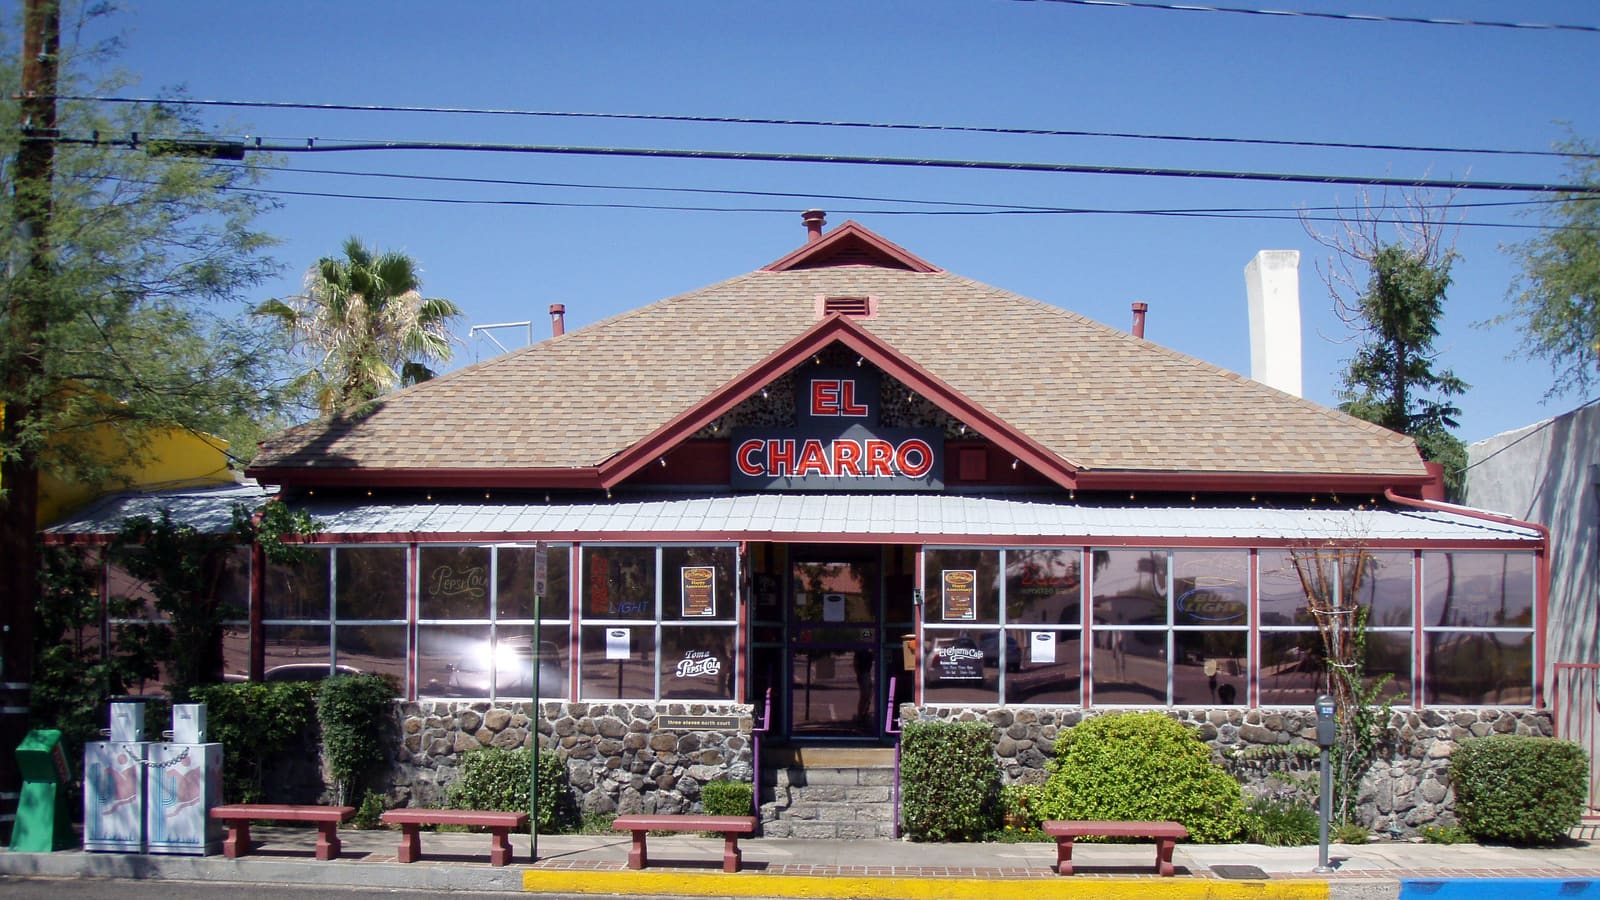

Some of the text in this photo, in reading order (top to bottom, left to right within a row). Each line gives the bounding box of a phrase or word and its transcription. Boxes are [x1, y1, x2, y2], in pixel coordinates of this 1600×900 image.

[810, 379, 868, 416] EL
[736, 438, 934, 478] CHARRO
[608, 600, 649, 614] LIGHT
